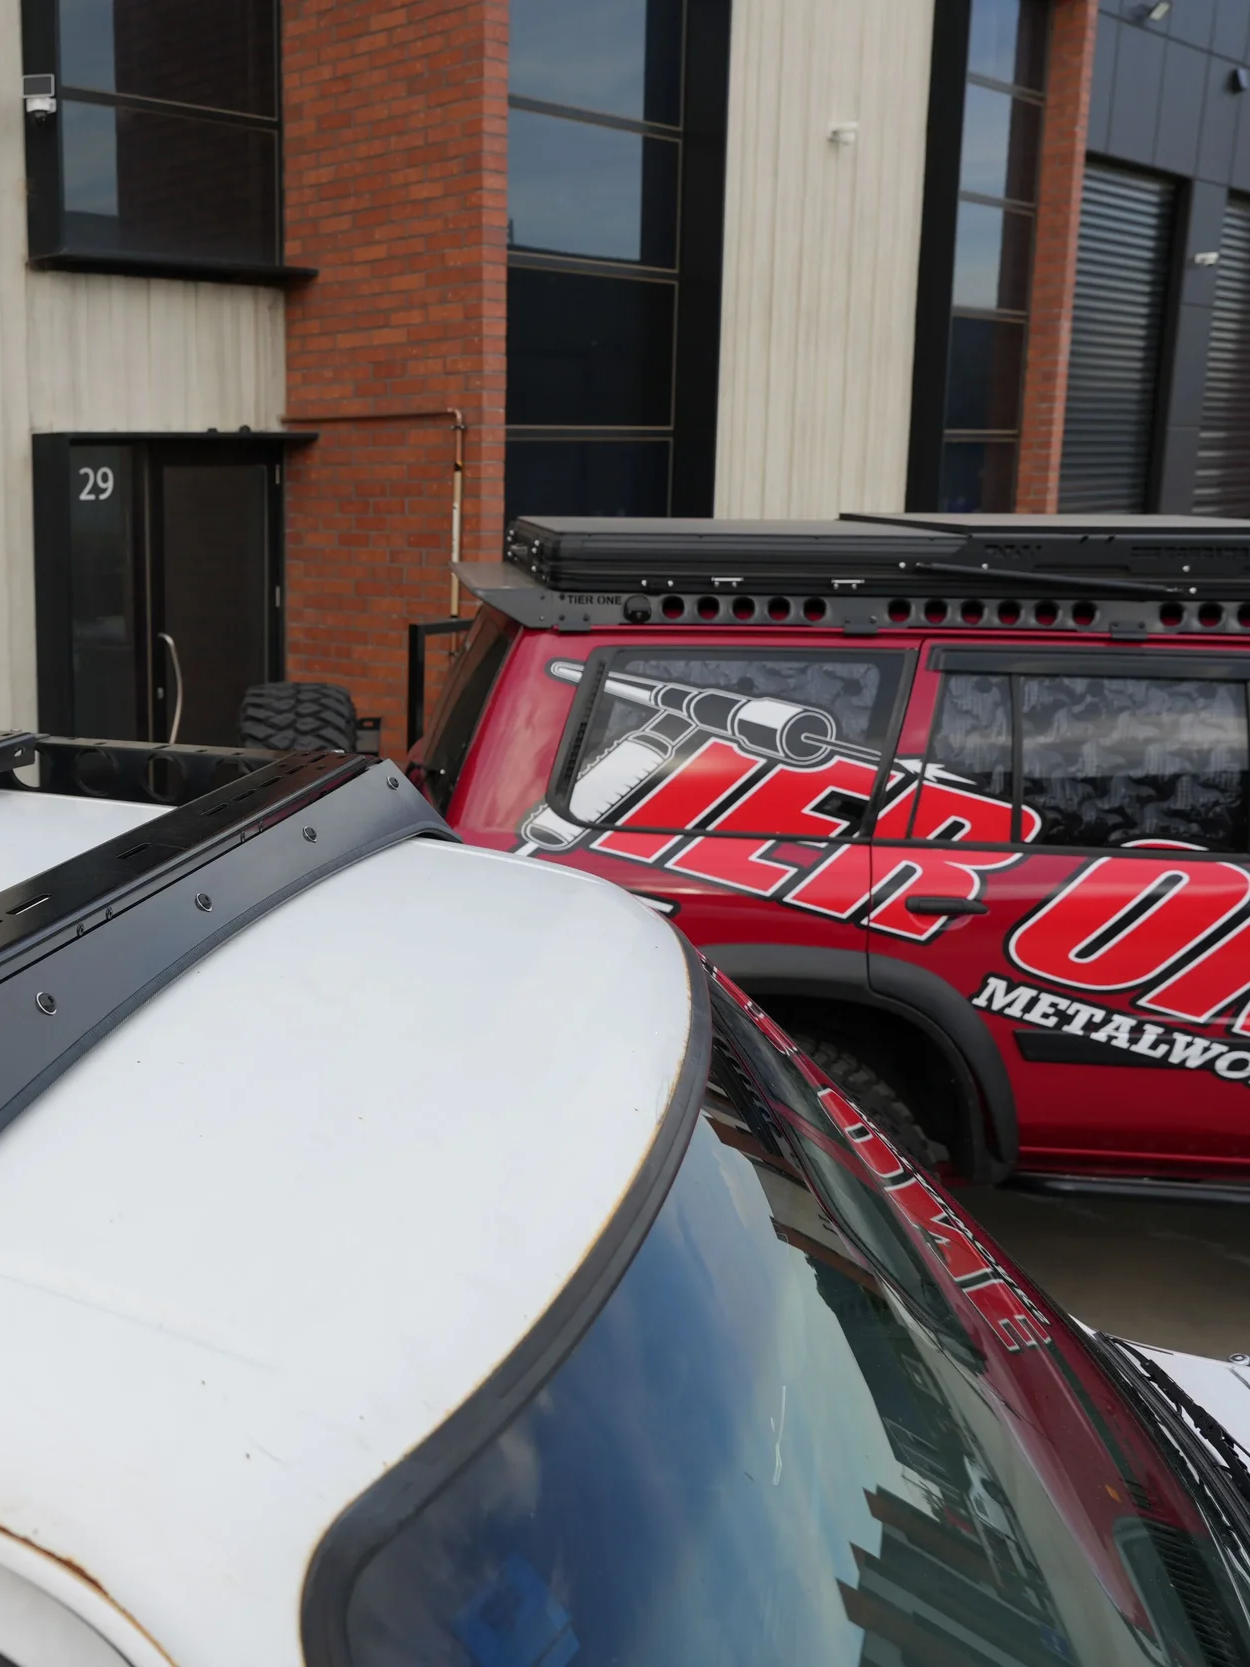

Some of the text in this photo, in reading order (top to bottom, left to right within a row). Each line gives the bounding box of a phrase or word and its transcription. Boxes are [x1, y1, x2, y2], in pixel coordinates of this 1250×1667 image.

[79, 466, 114, 500] 29
[567, 595, 622, 605] TIER ONE
